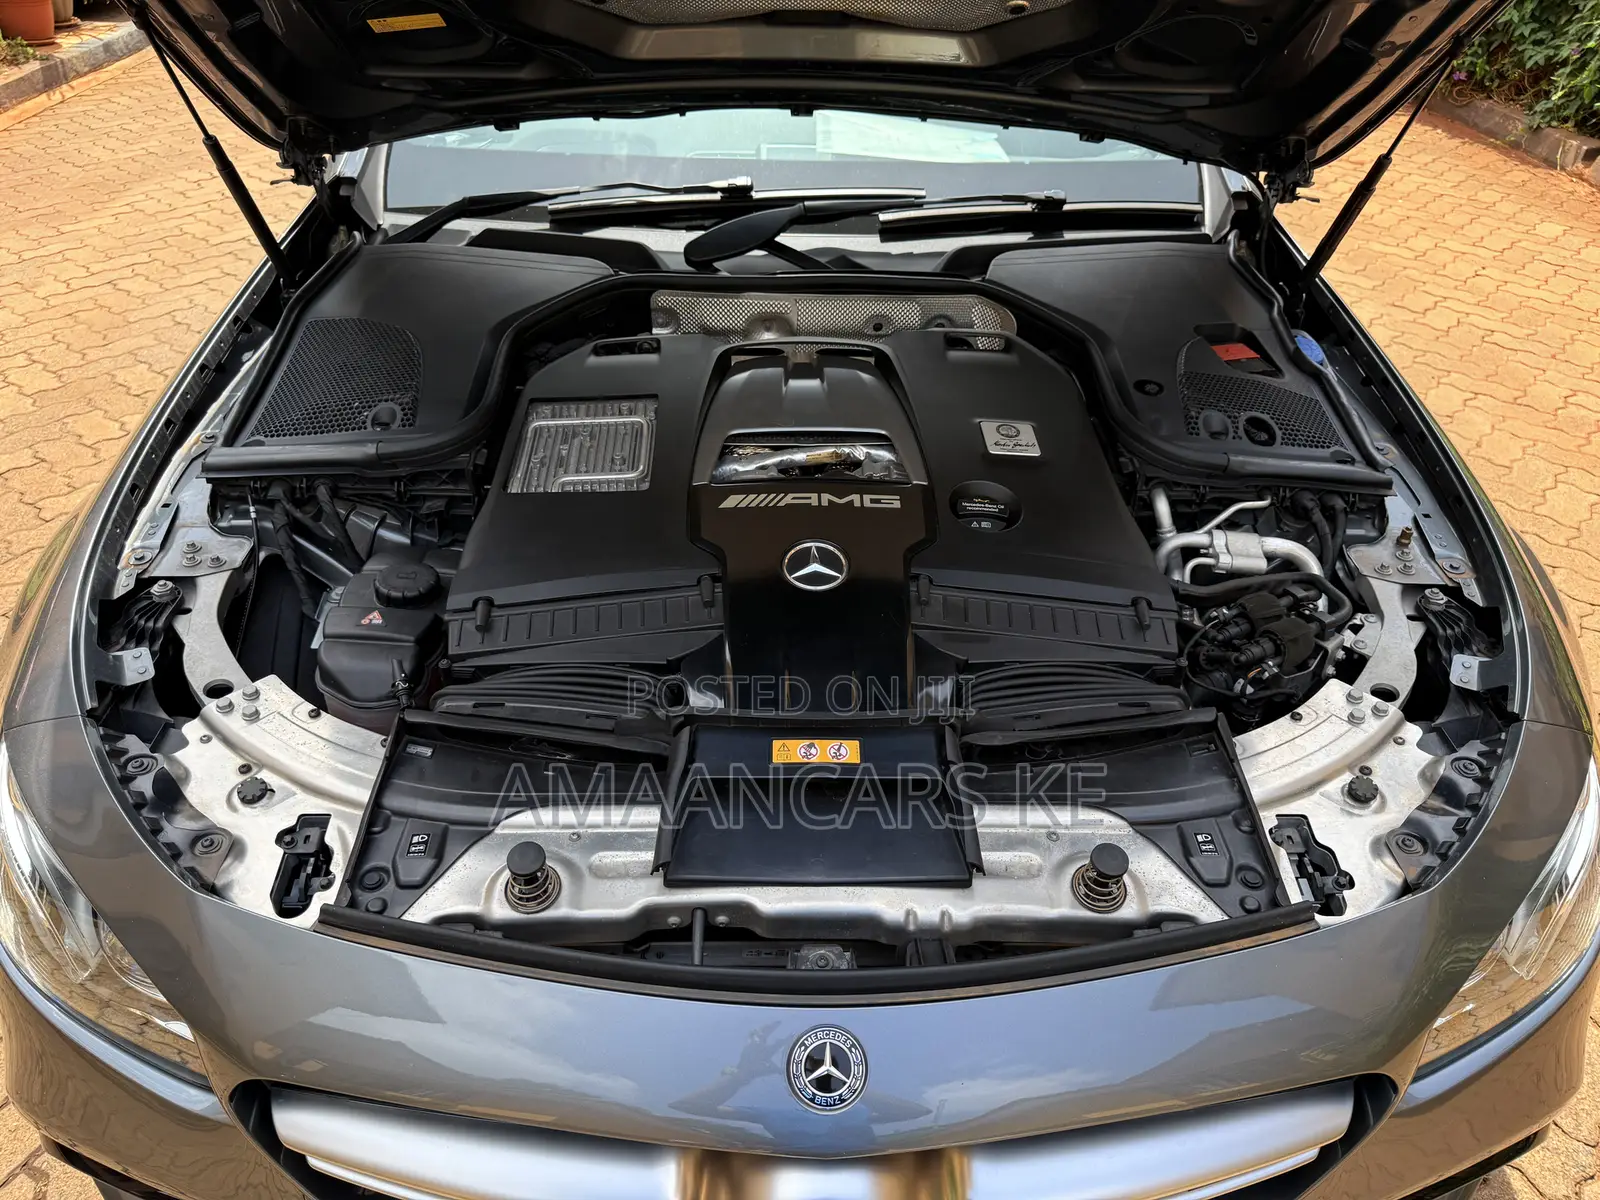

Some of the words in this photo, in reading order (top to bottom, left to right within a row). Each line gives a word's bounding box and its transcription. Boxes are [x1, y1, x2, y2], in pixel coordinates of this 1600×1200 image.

[776, 493, 901, 508] AMG
[804, 1031, 853, 1048] MERCEDES
[815, 1095, 841, 1106] BENZ
